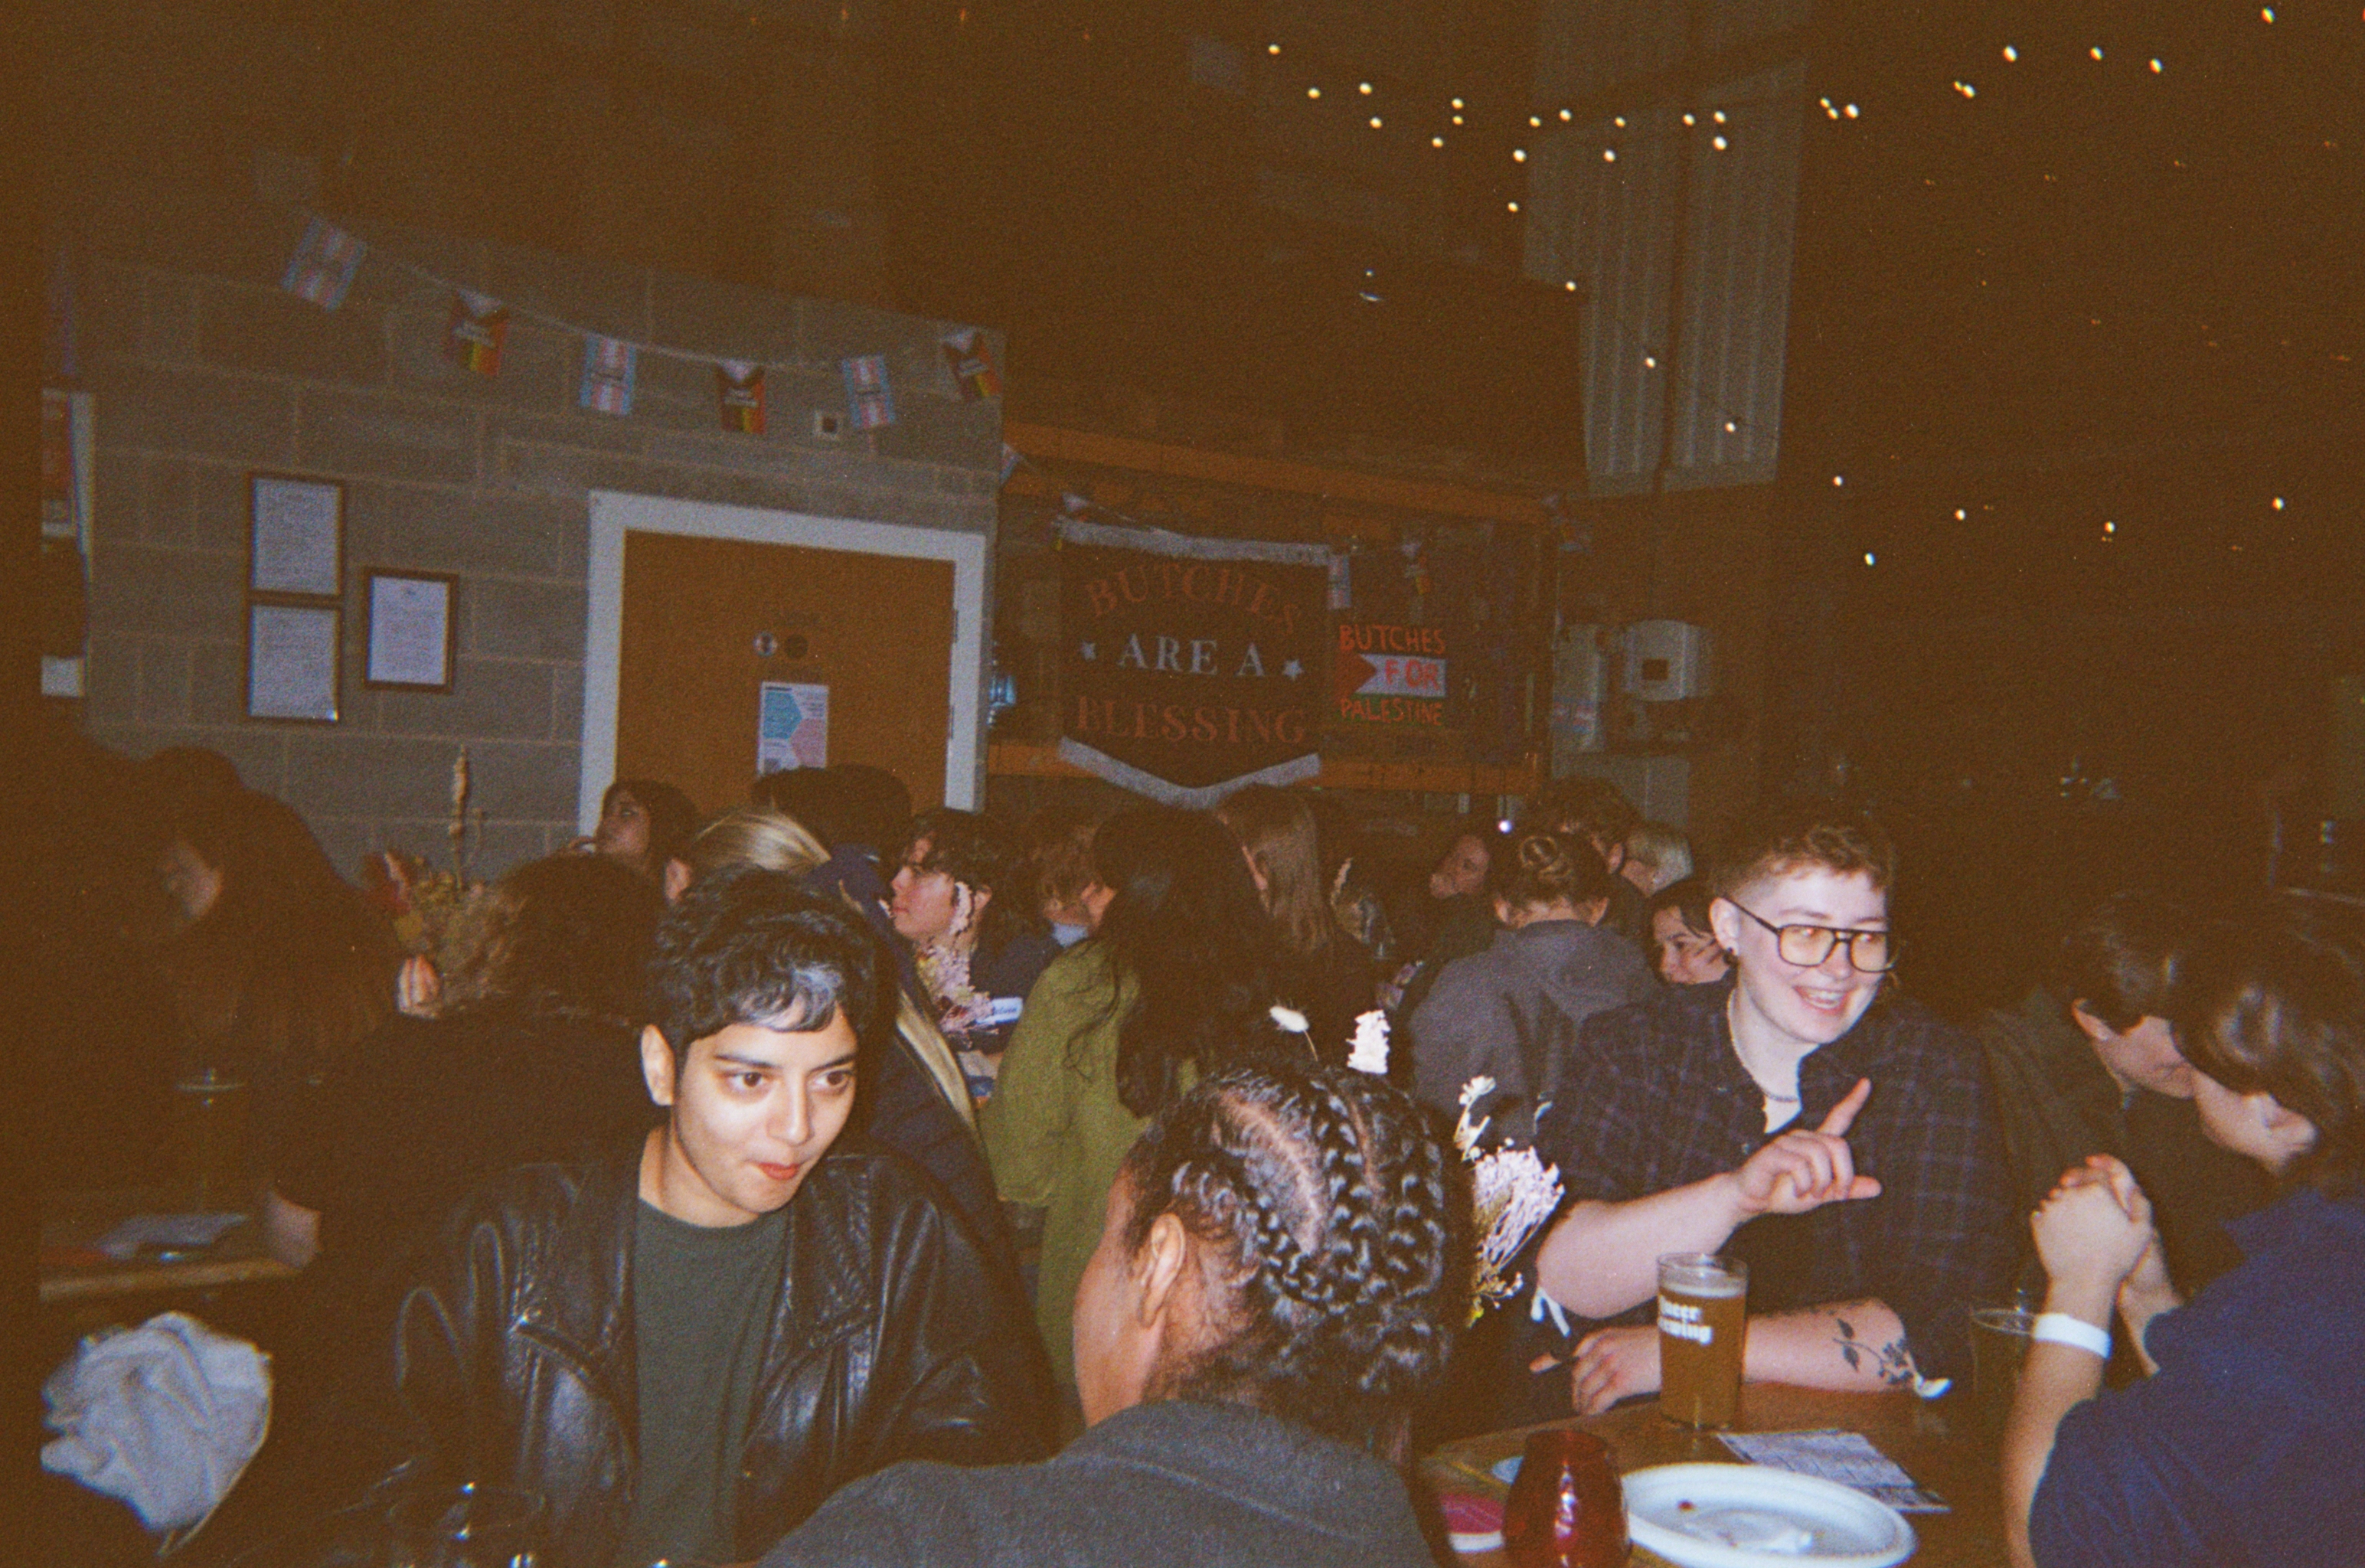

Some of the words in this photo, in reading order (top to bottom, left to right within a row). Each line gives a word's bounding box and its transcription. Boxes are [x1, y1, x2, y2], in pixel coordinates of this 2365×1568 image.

[1085, 563, 1304, 635] BUTCHES
[1116, 632, 1220, 676] ARE
[1233, 642, 1267, 677] A
[1340, 624, 1446, 655] BUTCHES
[1385, 658, 1441, 691] FOR
[1076, 695, 1305, 744] BLESSING
[1340, 697, 1443, 727] PALESTINE
